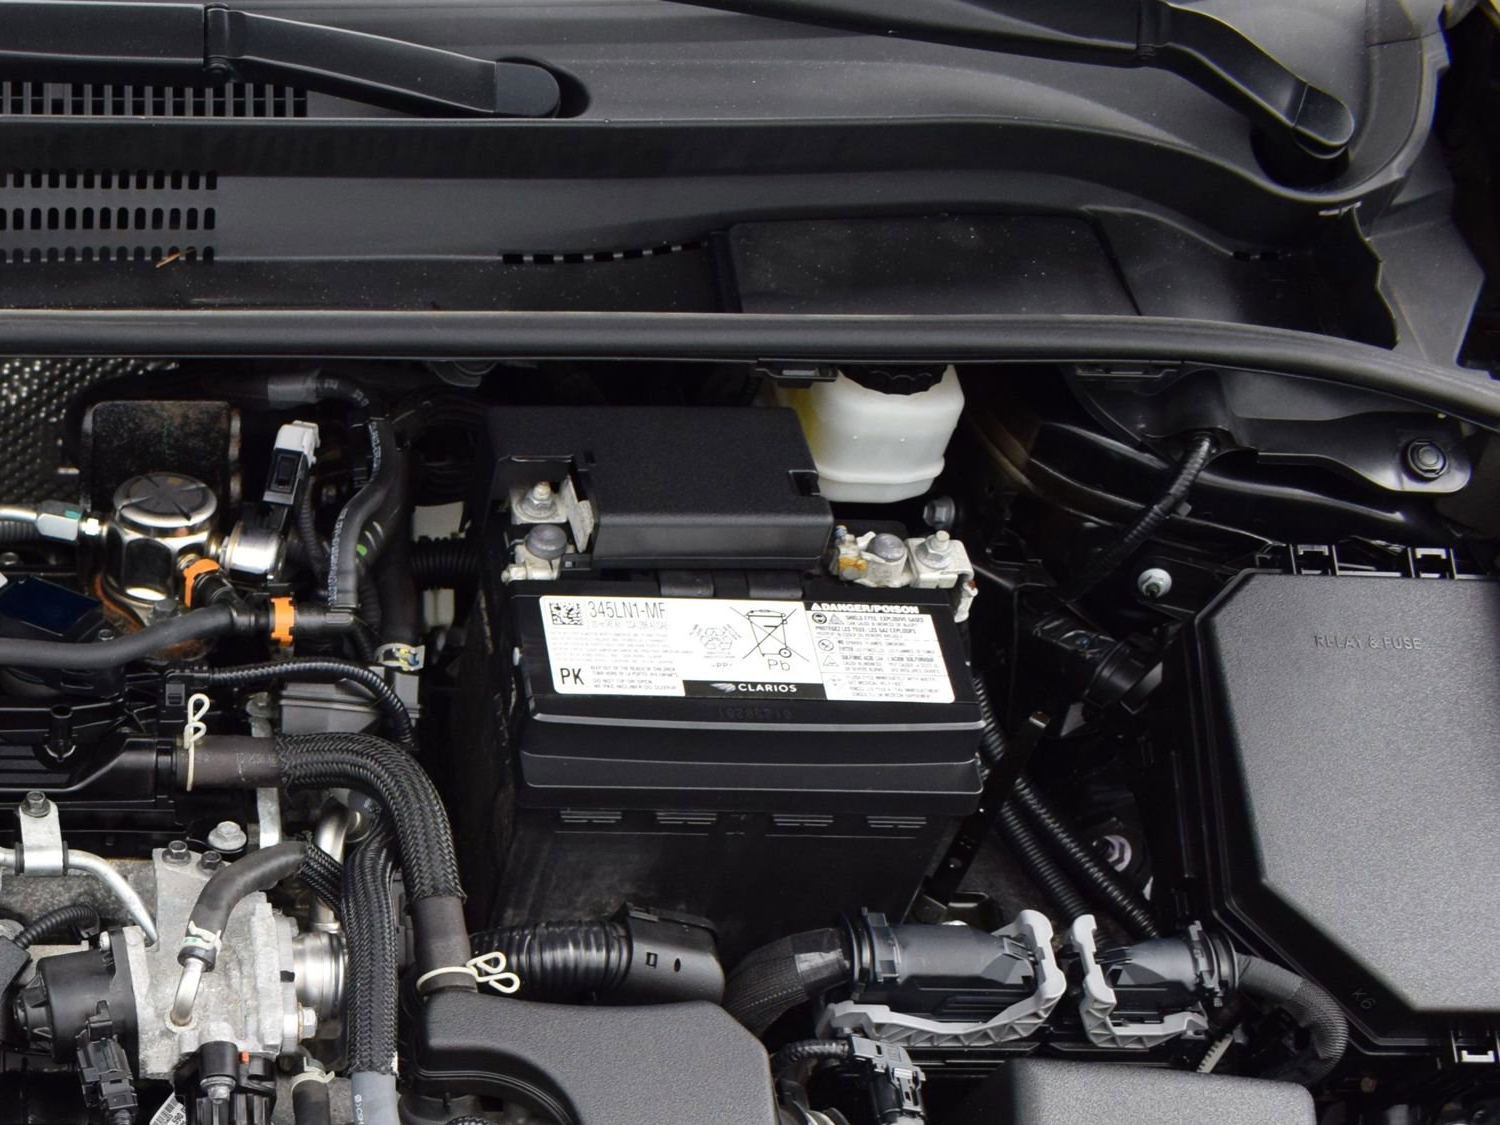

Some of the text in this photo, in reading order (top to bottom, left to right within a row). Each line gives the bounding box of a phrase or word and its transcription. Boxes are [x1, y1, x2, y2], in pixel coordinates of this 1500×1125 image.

[587, 601, 665, 619] 345LN1-MF
[821, 603, 919, 615] DANGER/POISON
[1314, 635, 1422, 650] RELAY & FUSE
[767, 658, 791, 671] Pb
[560, 668, 584, 685] PK
[737, 683, 797, 693] CLARIOS
